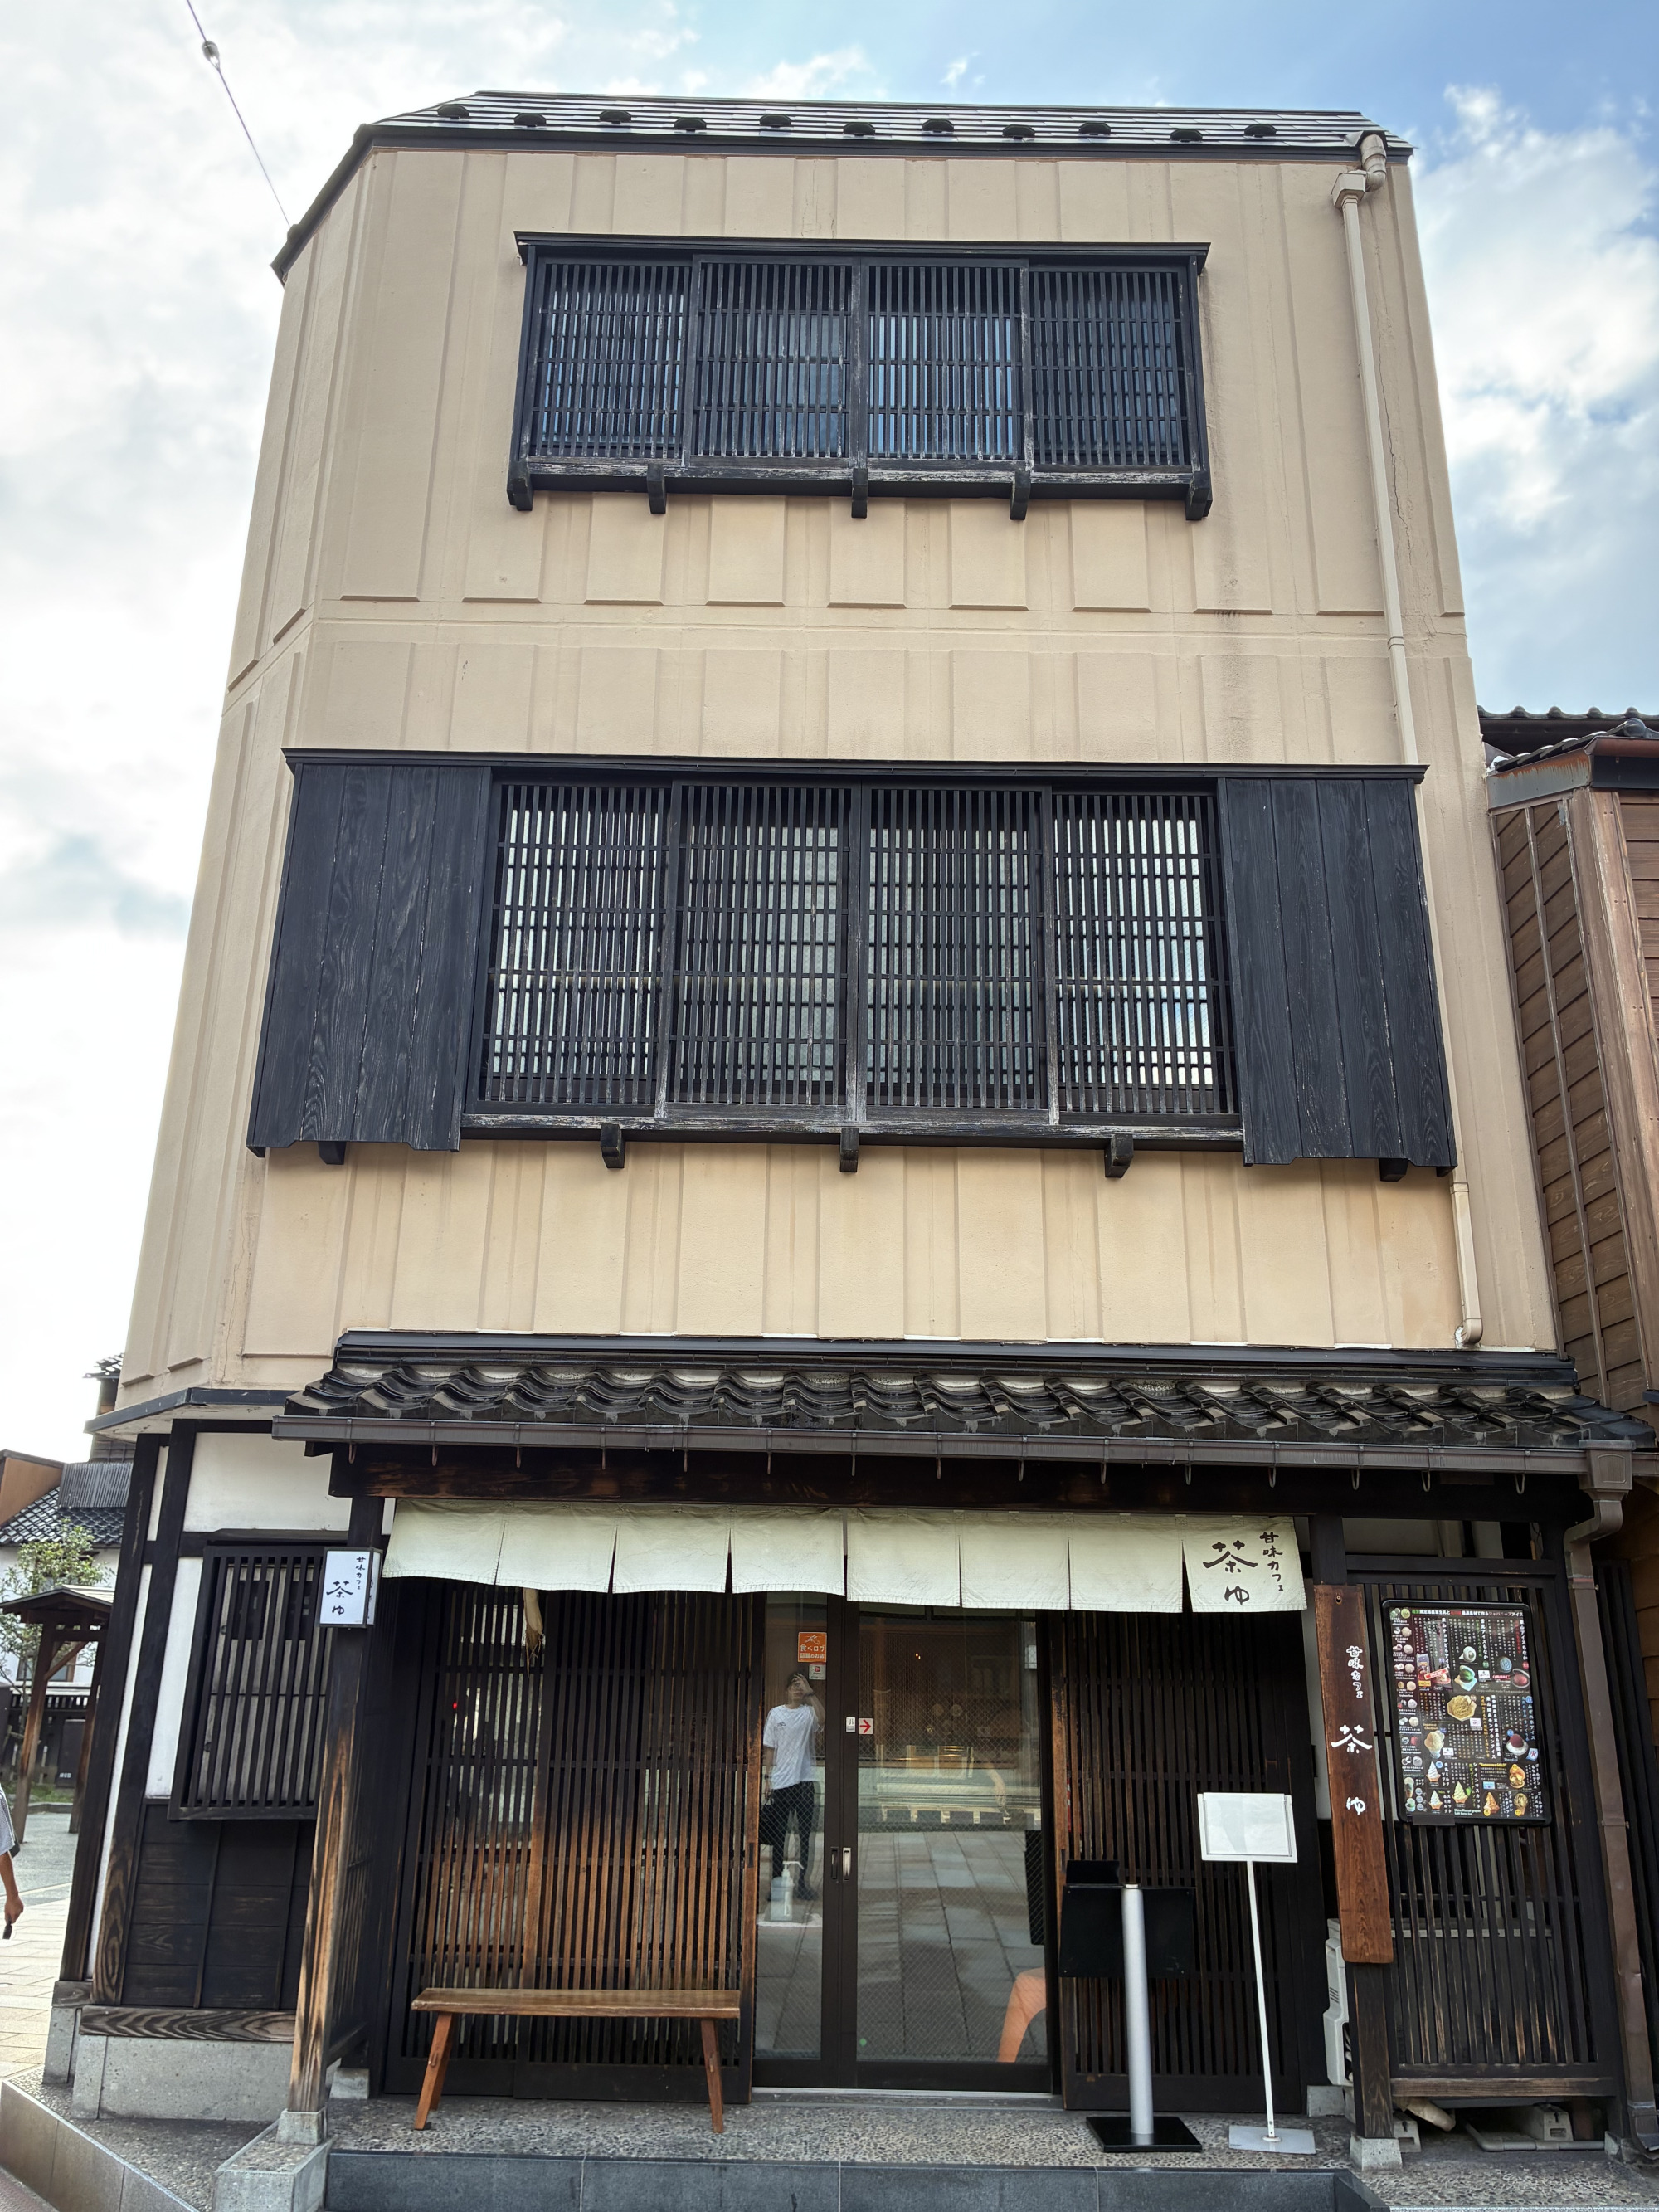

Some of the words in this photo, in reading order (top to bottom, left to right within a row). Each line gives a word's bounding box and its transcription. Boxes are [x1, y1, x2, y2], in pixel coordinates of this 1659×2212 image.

[355, 1556, 367, 1591] 甘味カフェ
[1203, 1540, 1258, 1605] 茶ゆ
[1259, 1532, 1283, 1591] 甘味カフェ
[326, 1580, 353, 1616] 茶ゆ
[800, 1644, 825, 1652] 食べログ
[1345, 1645, 1365, 1698] 甘味カフェ
[1331, 1724, 1373, 1815] 茶ゆ
